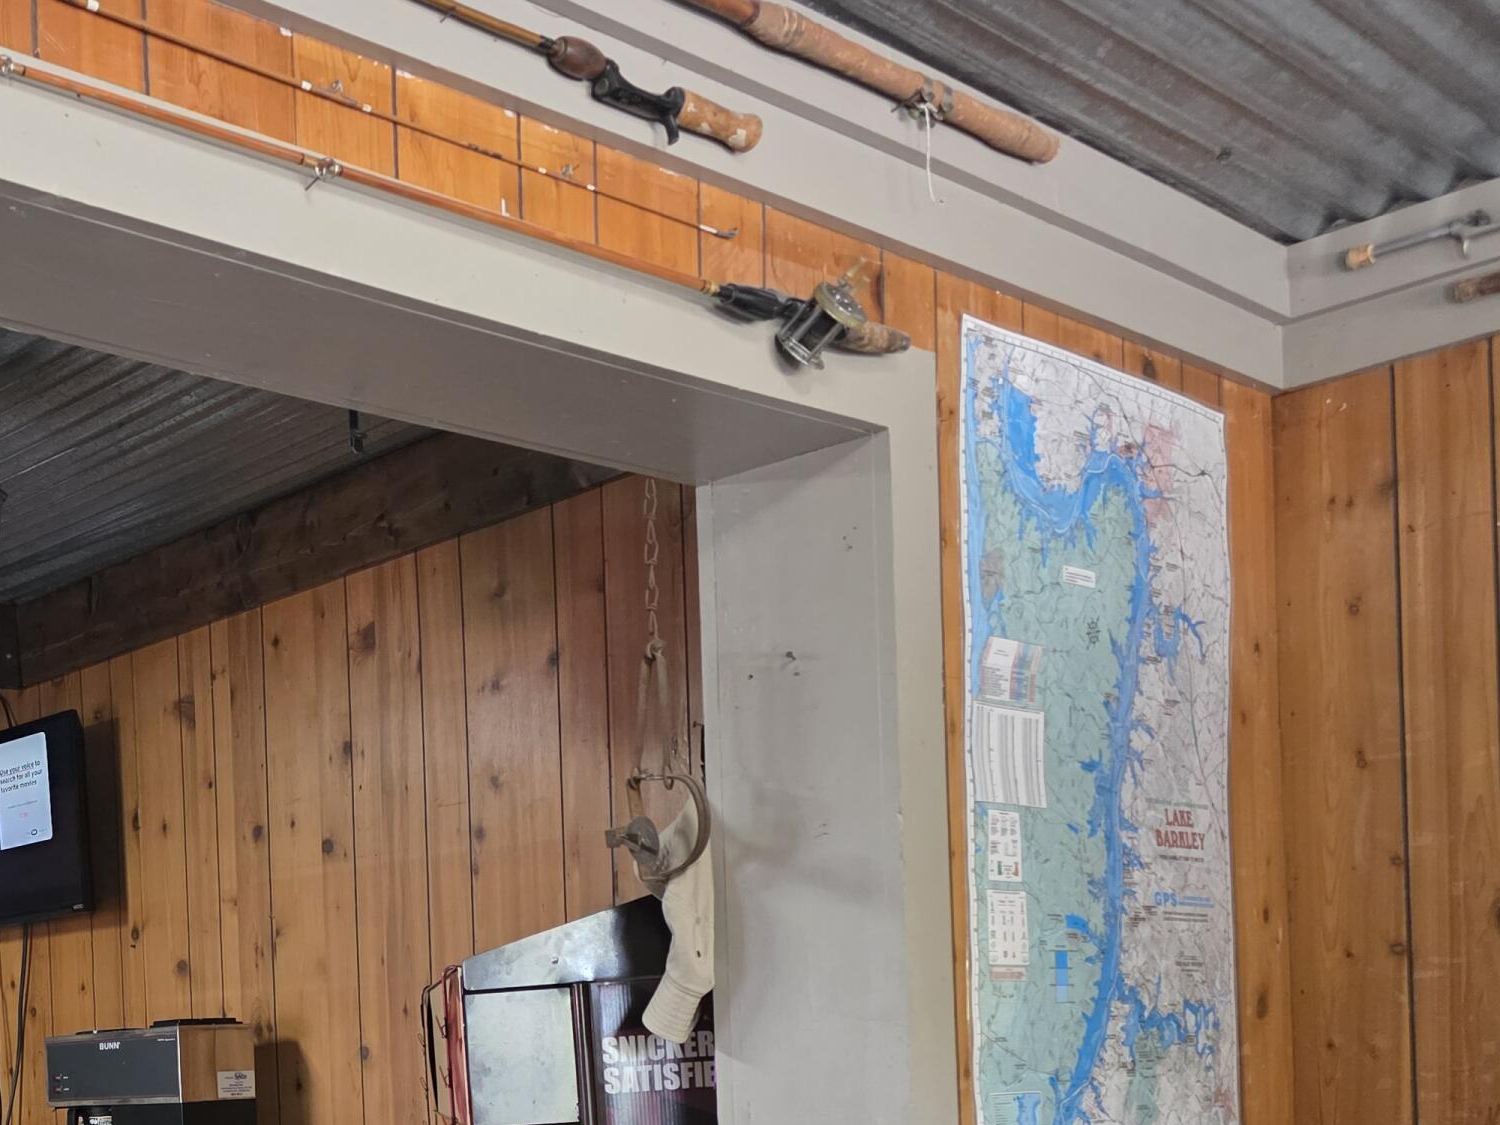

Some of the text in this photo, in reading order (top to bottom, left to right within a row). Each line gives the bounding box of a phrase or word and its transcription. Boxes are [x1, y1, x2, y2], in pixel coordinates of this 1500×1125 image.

[0, 775, 16, 785] search
[16, 773, 24, 781] for
[31, 769, 43, 779] your
[10, 765, 21, 777] your
[21, 763, 34, 772] voice
[0, 779, 37, 794] favorite movies
[1164, 808, 1195, 828] LAKE
[1155, 829, 1206, 851] BARKLEY
[1154, 892, 1178, 907] GPS
[99, 1042, 120, 1050] BUNN
